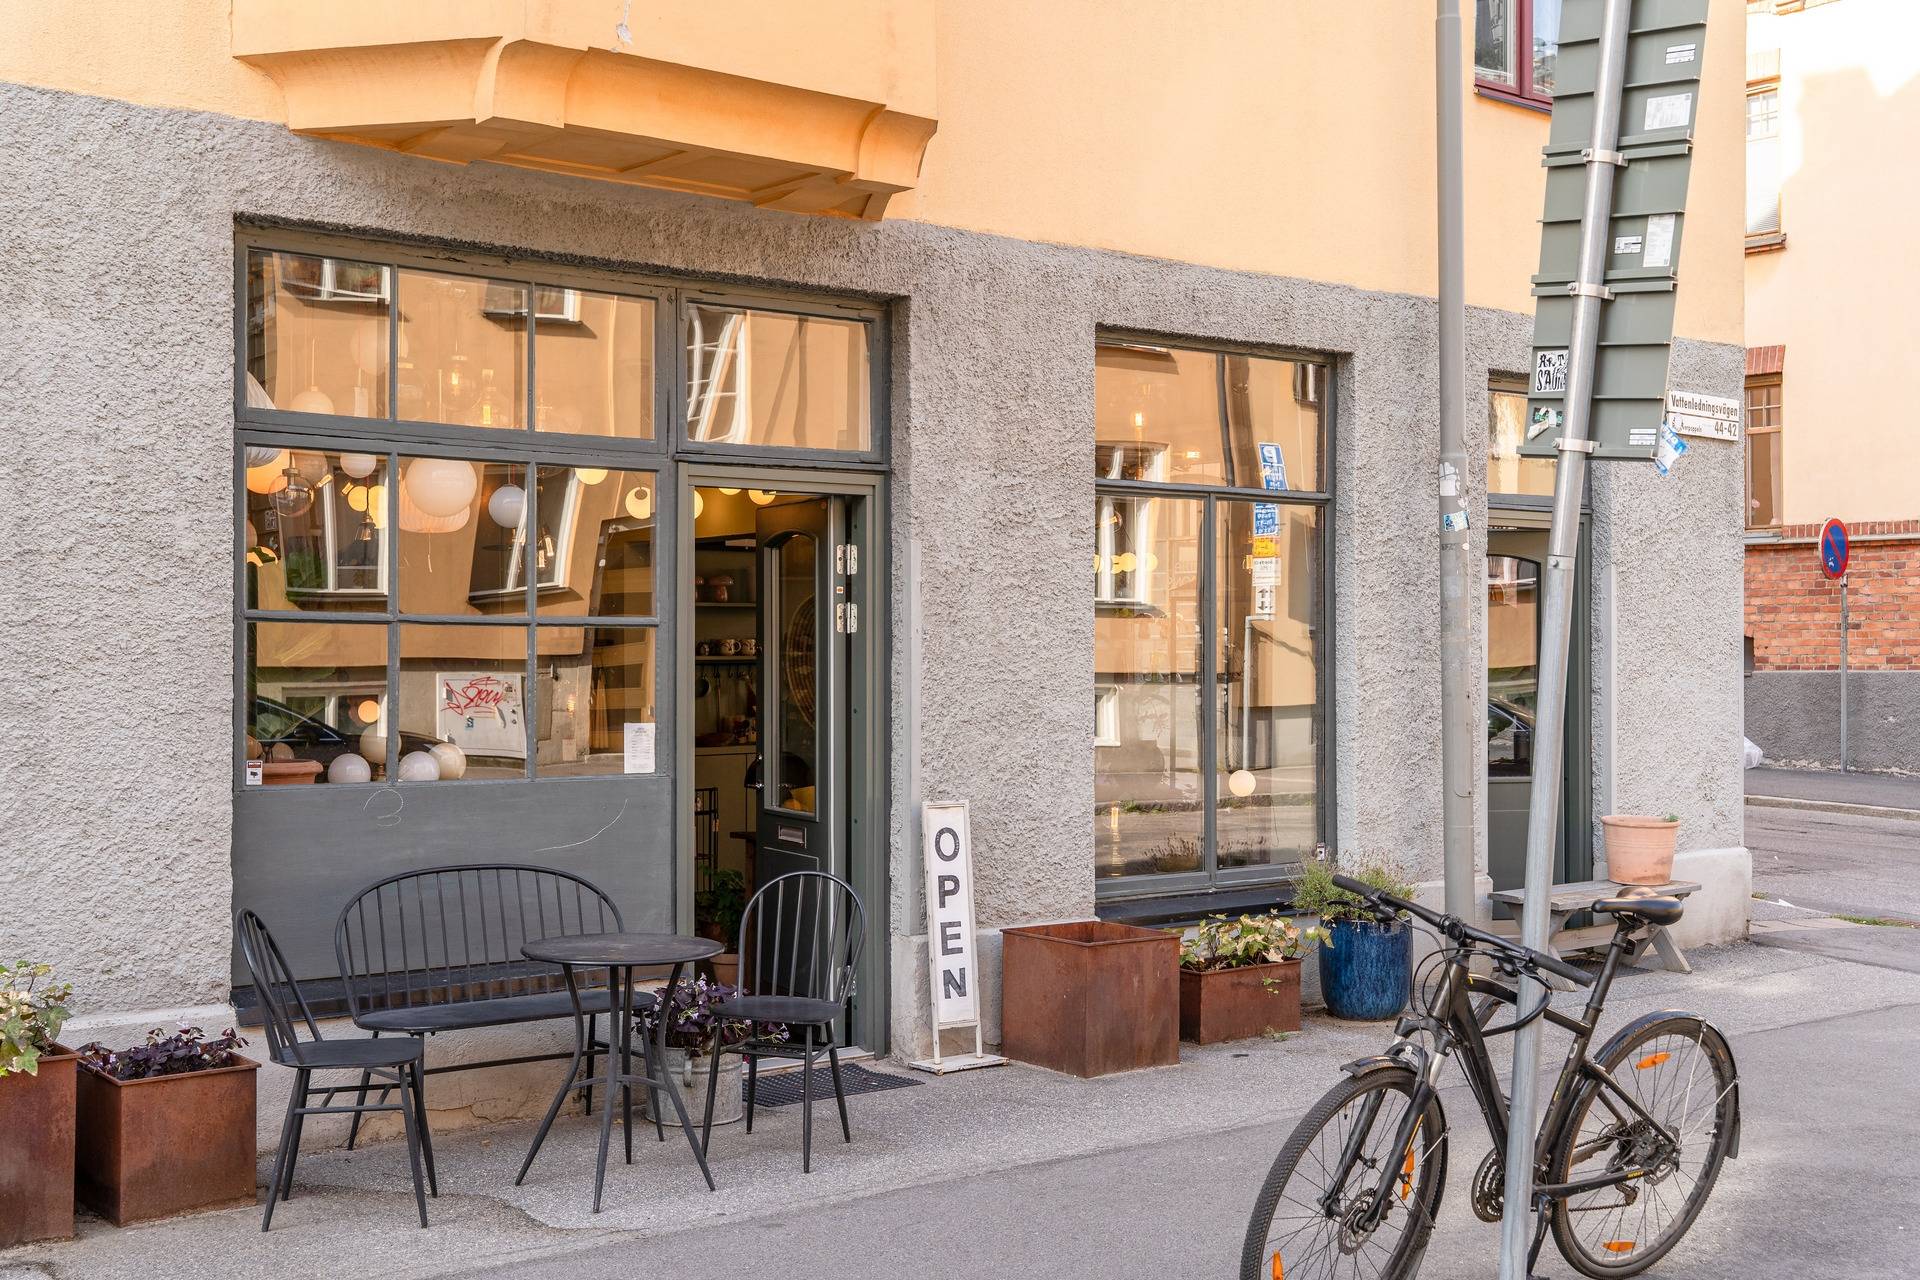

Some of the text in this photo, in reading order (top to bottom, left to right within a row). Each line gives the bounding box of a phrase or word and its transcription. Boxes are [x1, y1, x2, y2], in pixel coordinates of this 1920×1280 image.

[1671, 394, 1738, 418] Vattenledningsvägen
[1714, 421, 1737, 437] 44-42
[934, 826, 967, 999] OPEN
